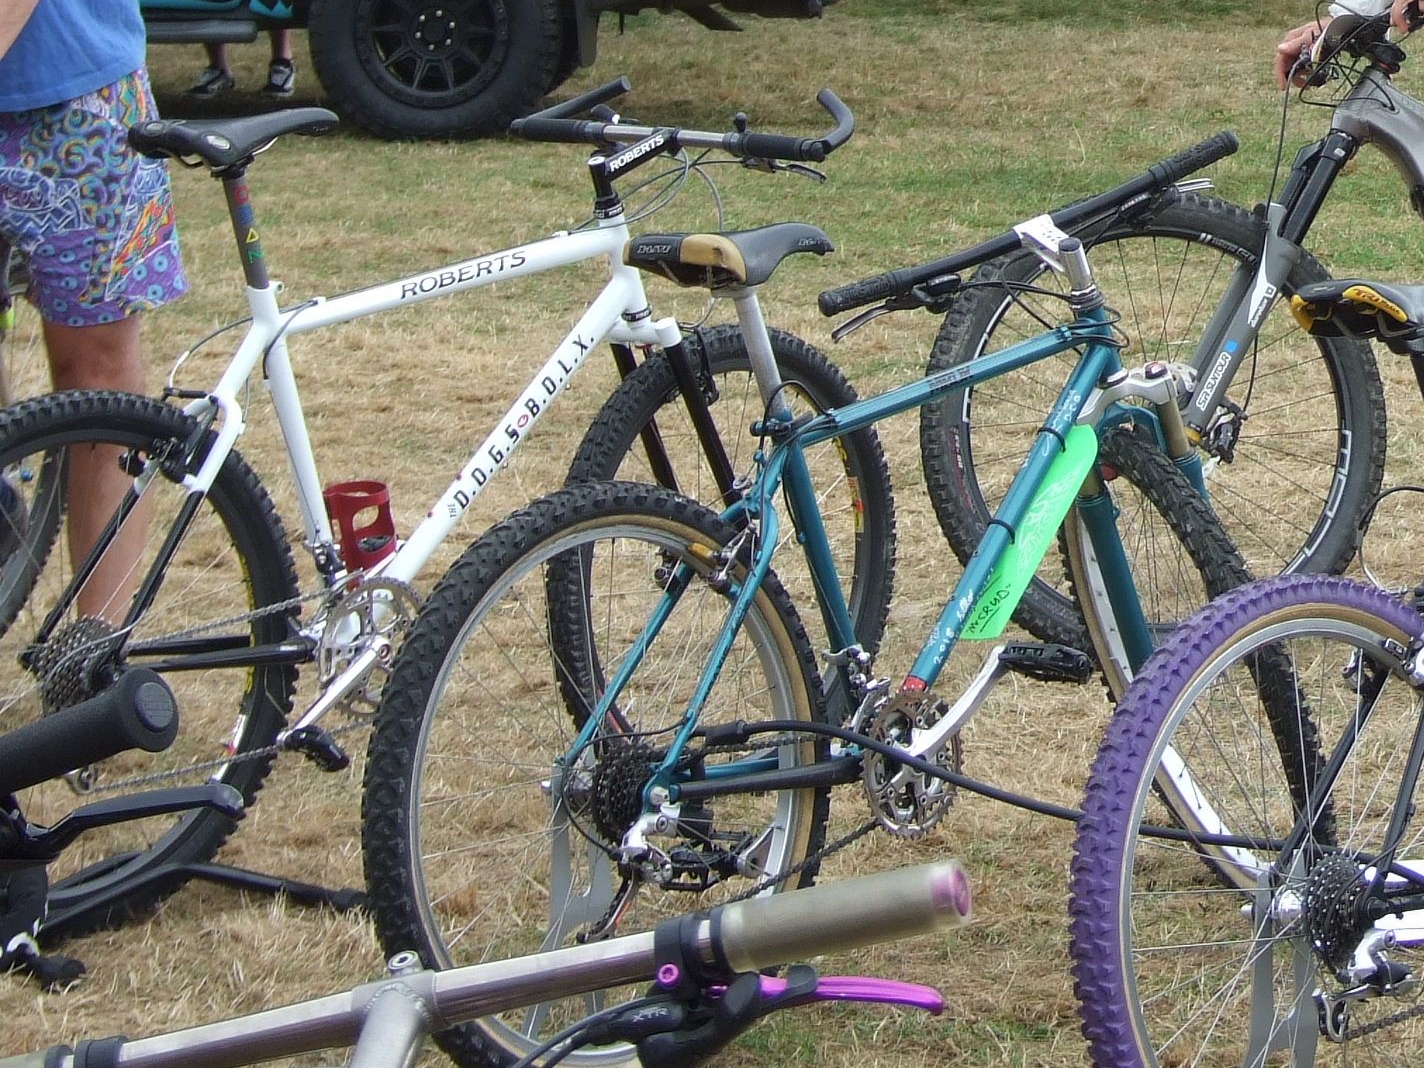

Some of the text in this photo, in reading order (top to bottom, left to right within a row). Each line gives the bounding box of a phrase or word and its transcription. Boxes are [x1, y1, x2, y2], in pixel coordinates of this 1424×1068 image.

[609, 134, 665, 173] ROBERTS
[400, 250, 526, 300] ROBERTS
[1206, 352, 1232, 393] SUNTOUR
[631, 1006, 668, 1023] XTR
